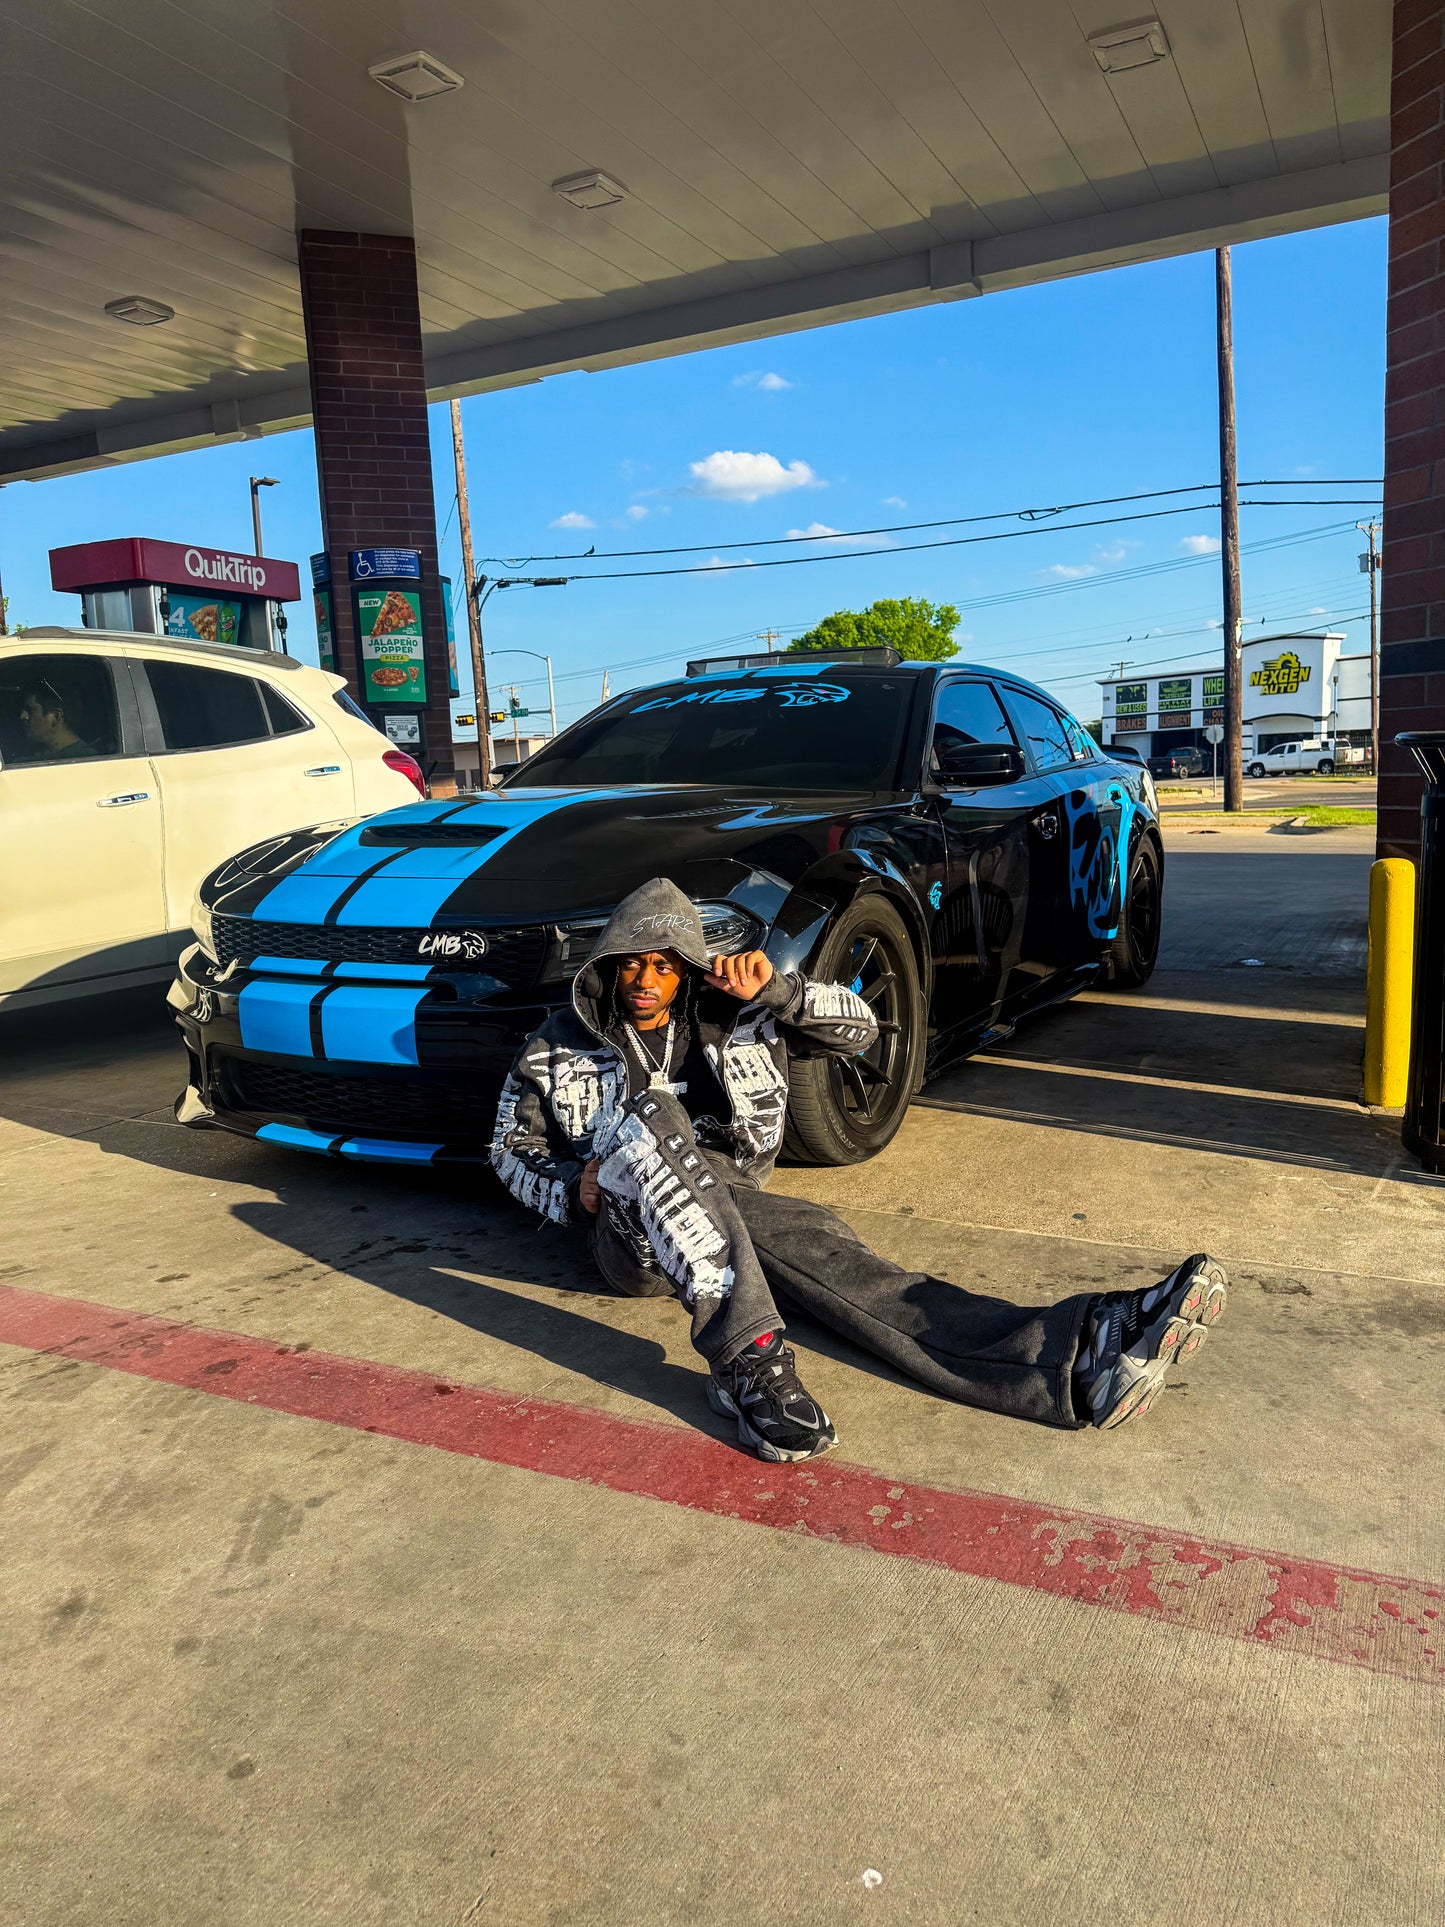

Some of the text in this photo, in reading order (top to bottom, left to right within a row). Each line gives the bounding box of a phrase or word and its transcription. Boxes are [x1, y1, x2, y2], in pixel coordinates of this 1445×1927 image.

[185, 549, 266, 591] QuikTrip
[368, 637, 418, 647] JALAPEÑO
[374, 646, 413, 654] POPPER
[1250, 666, 1311, 686] NEXGEN
[1261, 682, 1299, 694] AUTO
[1204, 696, 1220, 706] LIFT
[1117, 717, 1146, 731] BRAKES
[1159, 714, 1190, 728] ALIGNMENT
[418, 934, 461, 955] CMB
